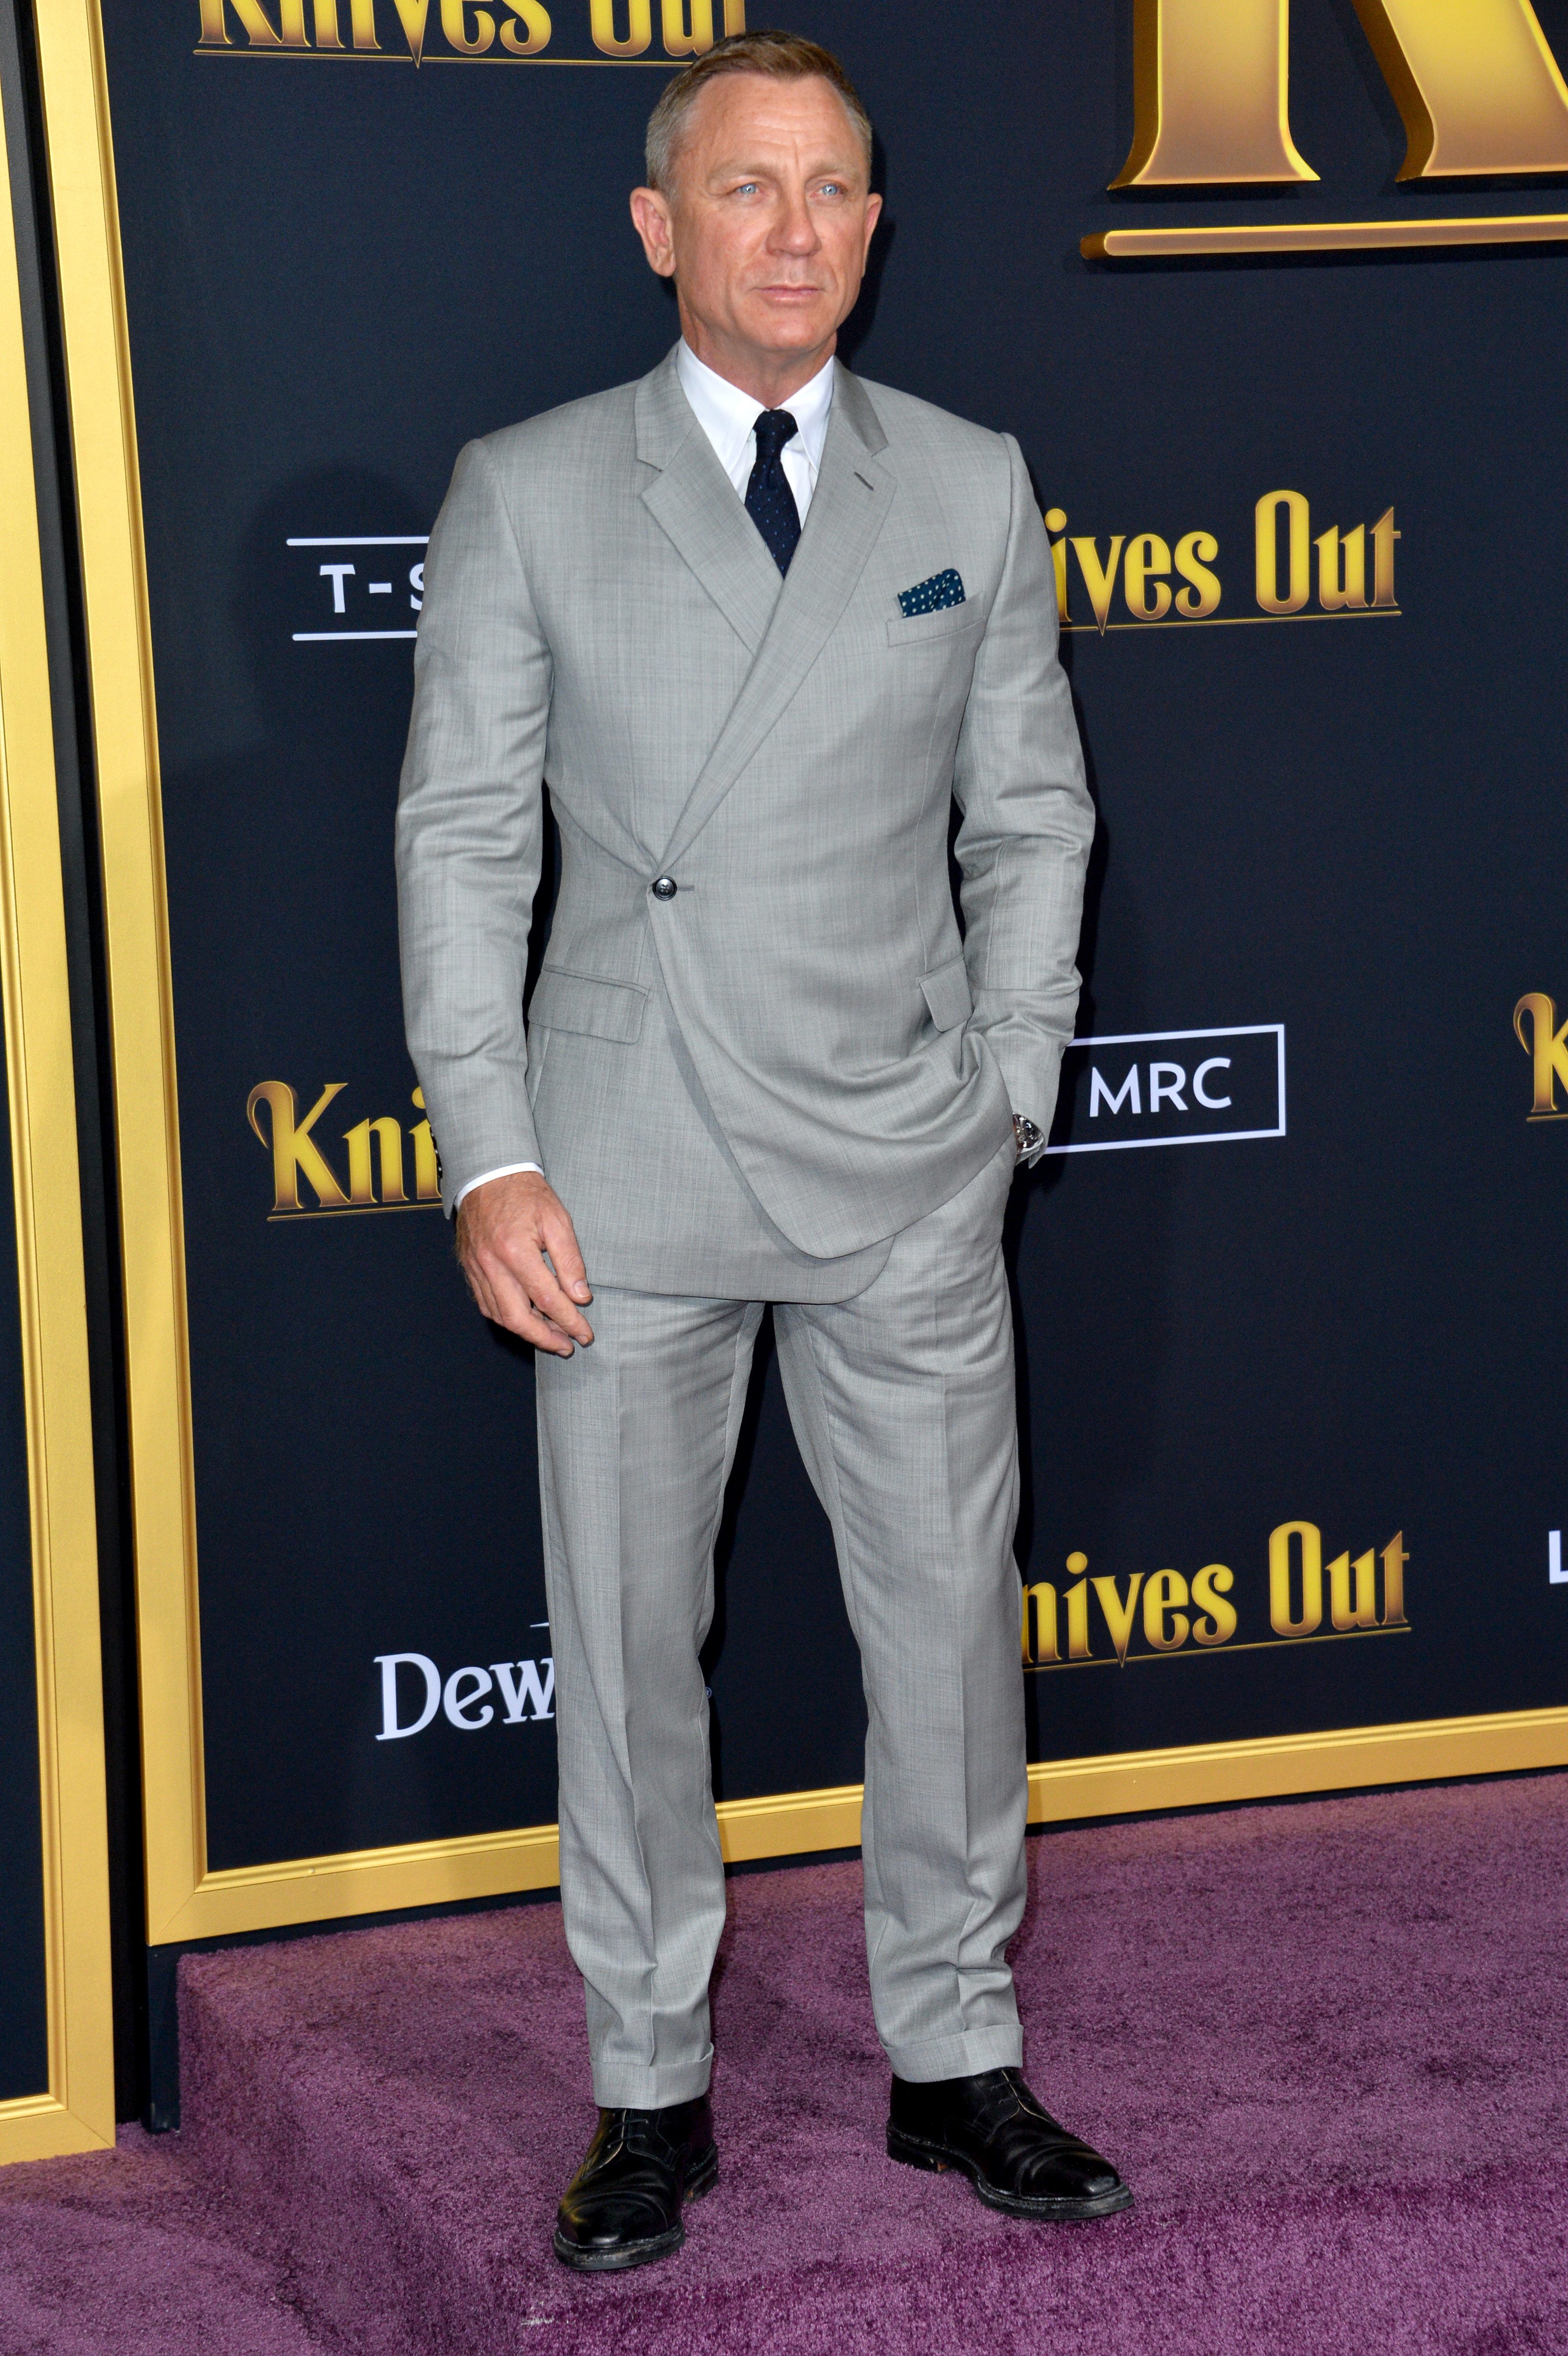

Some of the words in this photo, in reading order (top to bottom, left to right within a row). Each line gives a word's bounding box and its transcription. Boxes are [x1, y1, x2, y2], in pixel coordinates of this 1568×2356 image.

[1255, 490, 1401, 614] Out
[1089, 1058, 1231, 1117] MRC
[1269, 1521, 1410, 1637] Out
